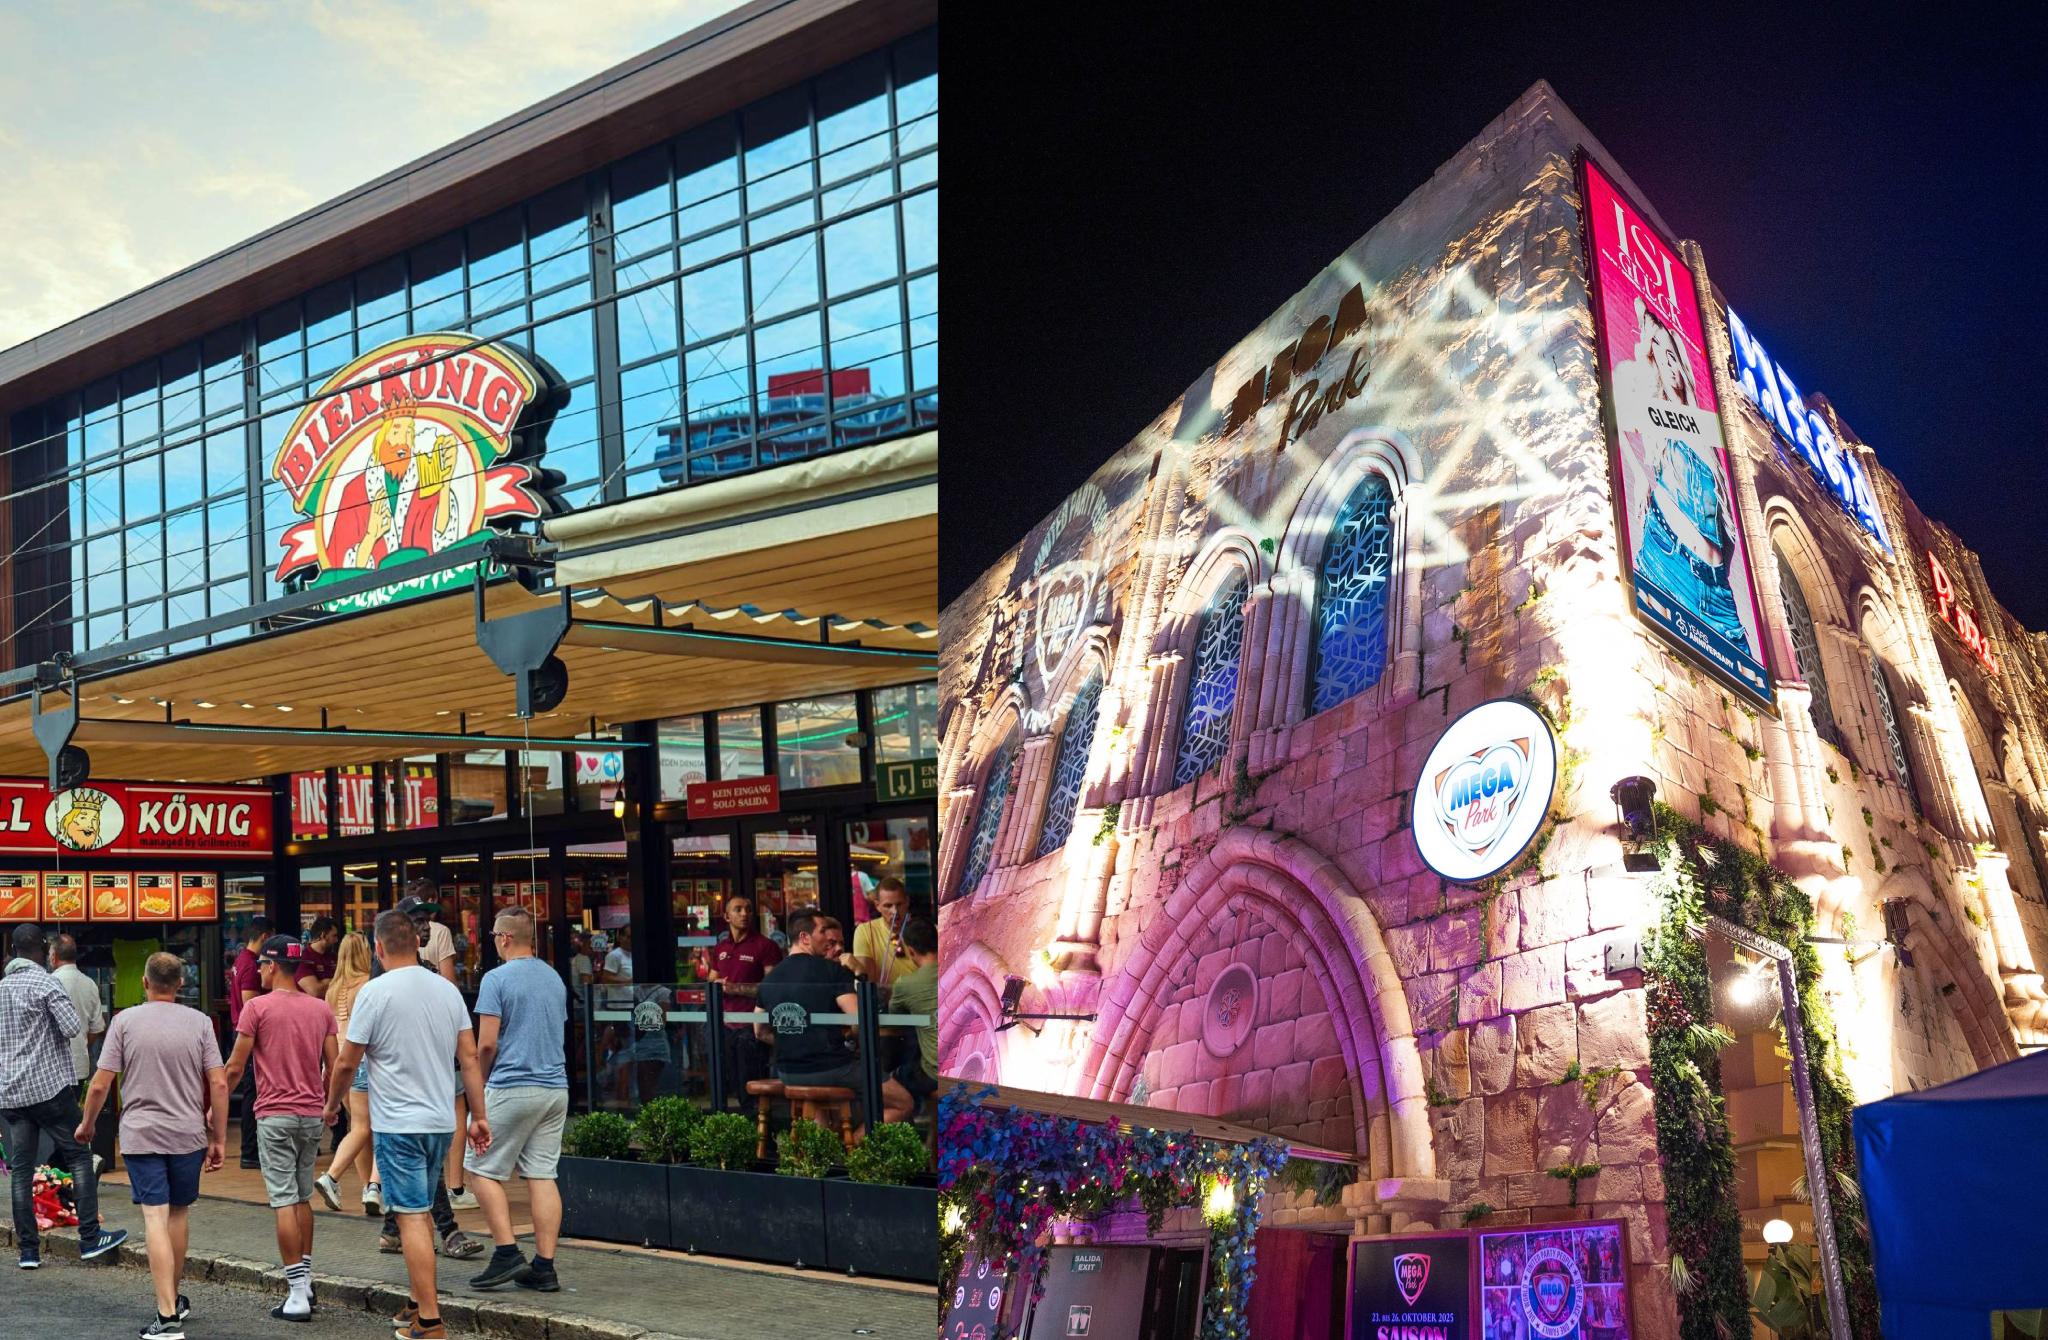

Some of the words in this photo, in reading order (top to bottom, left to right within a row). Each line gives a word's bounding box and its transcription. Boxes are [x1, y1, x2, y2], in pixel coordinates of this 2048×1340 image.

[1277, 346, 1371, 453] Park
[280, 347, 518, 487] BIERKÖNIG
[1647, 406, 1701, 435] GLEICH
[1675, 611, 1688, 637] 25
[1689, 632, 1734, 670] ANNIVERSARY
[712, 788, 732, 799] KEIN
[734, 784, 771, 797] EINGANG
[1450, 761, 1515, 812] MEGA
[138, 794, 250, 836] KÖNIG
[713, 800, 736, 810] SOLO
[739, 796, 769, 807] SALIDA
[1464, 796, 1499, 831] Park
[1540, 1248, 1556, 1258] PARTY
[1078, 1263, 1096, 1271] EXIT
[1401, 1265, 1422, 1278] MEGA
[1402, 1312, 1437, 1323] OKTOBER
[1438, 1312, 1454, 1322] 2025
[1377, 1325, 1448, 1340] SAISON
